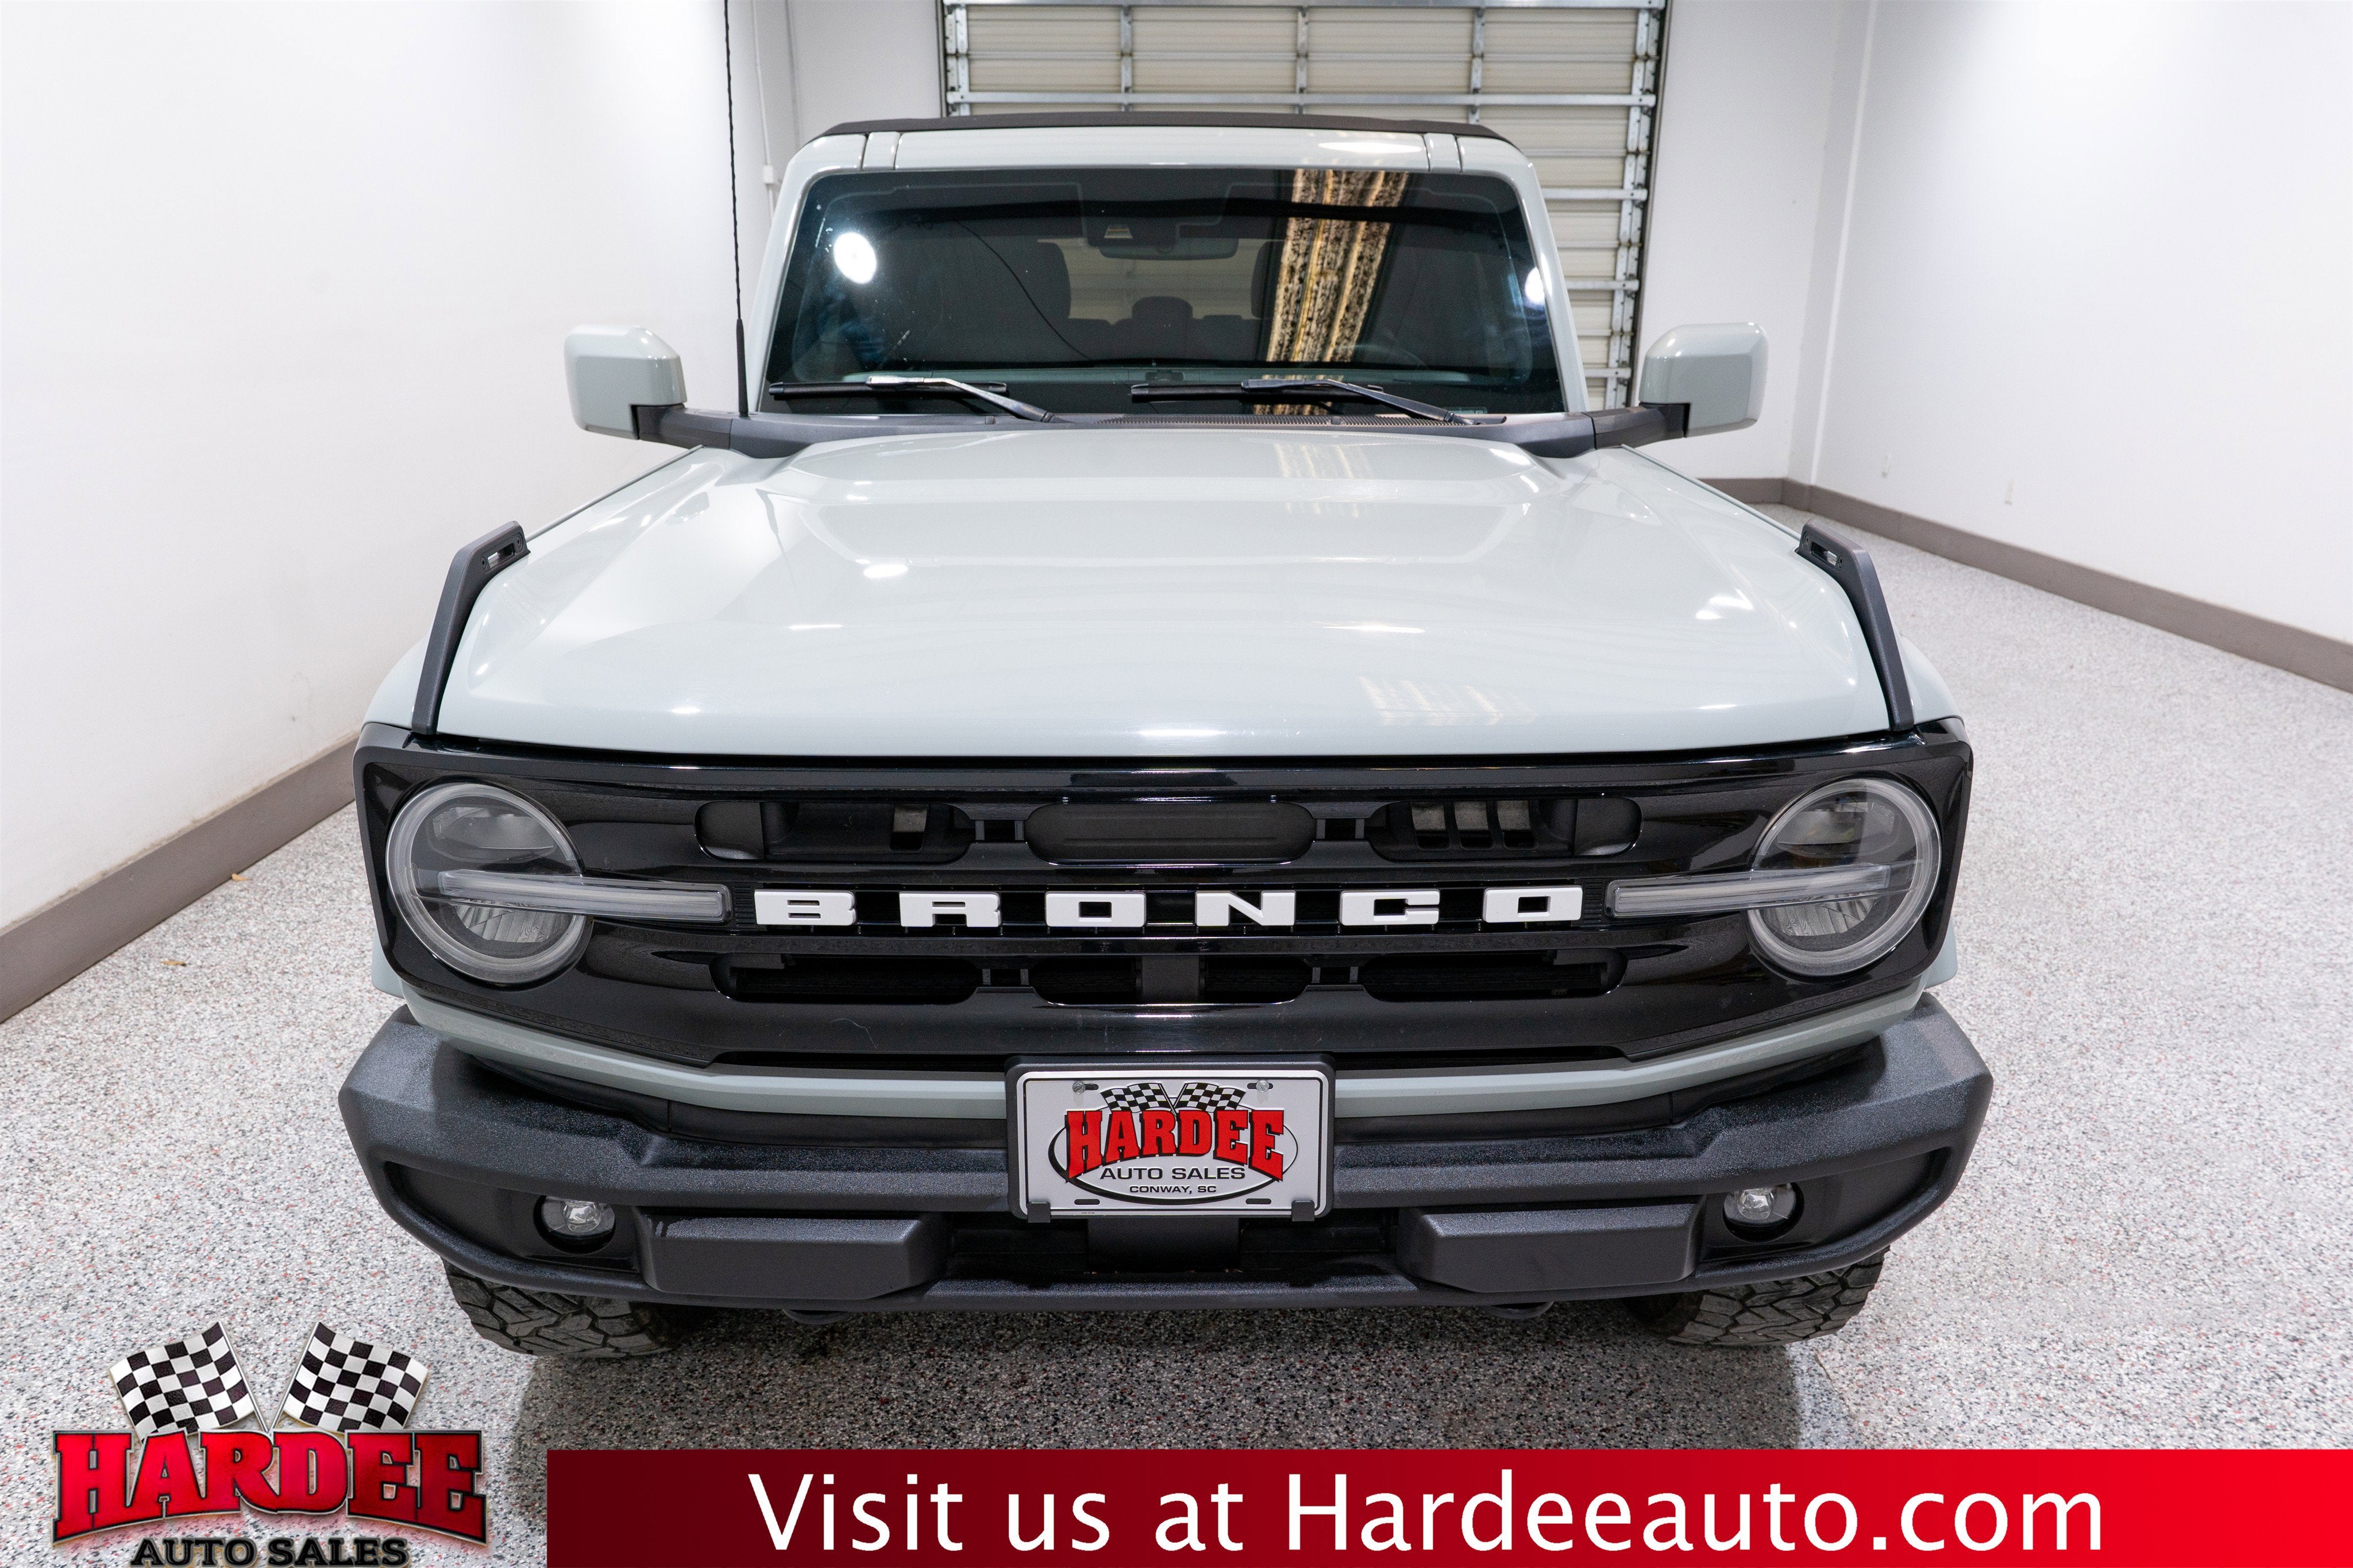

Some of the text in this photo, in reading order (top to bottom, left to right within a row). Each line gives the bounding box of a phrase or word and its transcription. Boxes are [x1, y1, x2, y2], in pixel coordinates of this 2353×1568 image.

[754, 885, 1583, 928] BRONCO
[1066, 1110, 1284, 1182] HARDEE
[1100, 1167, 1245, 1180] AUTO SALES
[1129, 1185, 1193, 1194] CONWAY,
